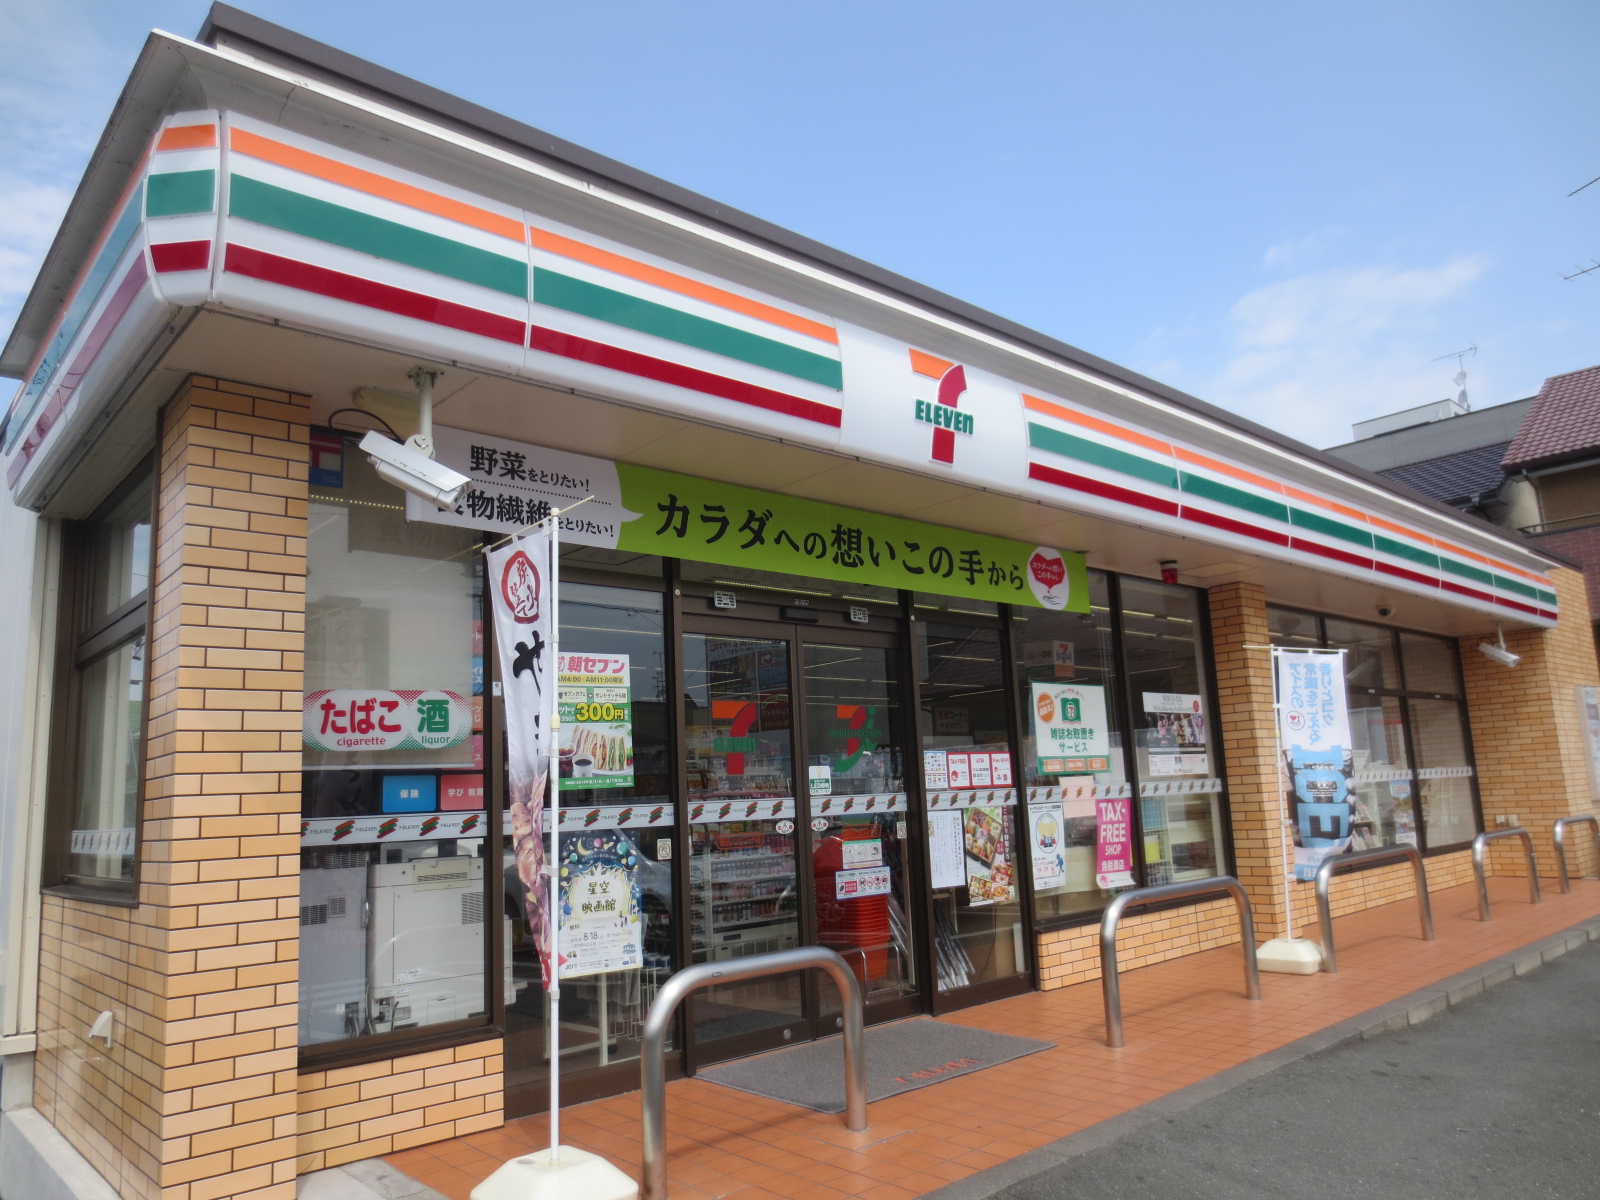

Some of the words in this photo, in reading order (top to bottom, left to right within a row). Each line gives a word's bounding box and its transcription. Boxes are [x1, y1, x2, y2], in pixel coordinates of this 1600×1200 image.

[915, 398, 974, 435] ELEVEN
[470, 444, 590, 491] 野菜をとりたい!
[655, 493, 1025, 591] カラダへの想いこの手から
[567, 656, 625, 674] 朝セブン
[320, 697, 402, 736] たばこ
[417, 698, 450, 733] 酒
[336, 736, 386, 748] cigarette
[421, 736, 451, 745] liquor
[1059, 742, 1088, 752] サービス
[400, 788, 420, 799] 保険
[1100, 822, 1126, 844] FREE
[1105, 844, 1122, 856] SHOP
[588, 880, 611, 896] 星空
[582, 898, 617, 915] 映画館
